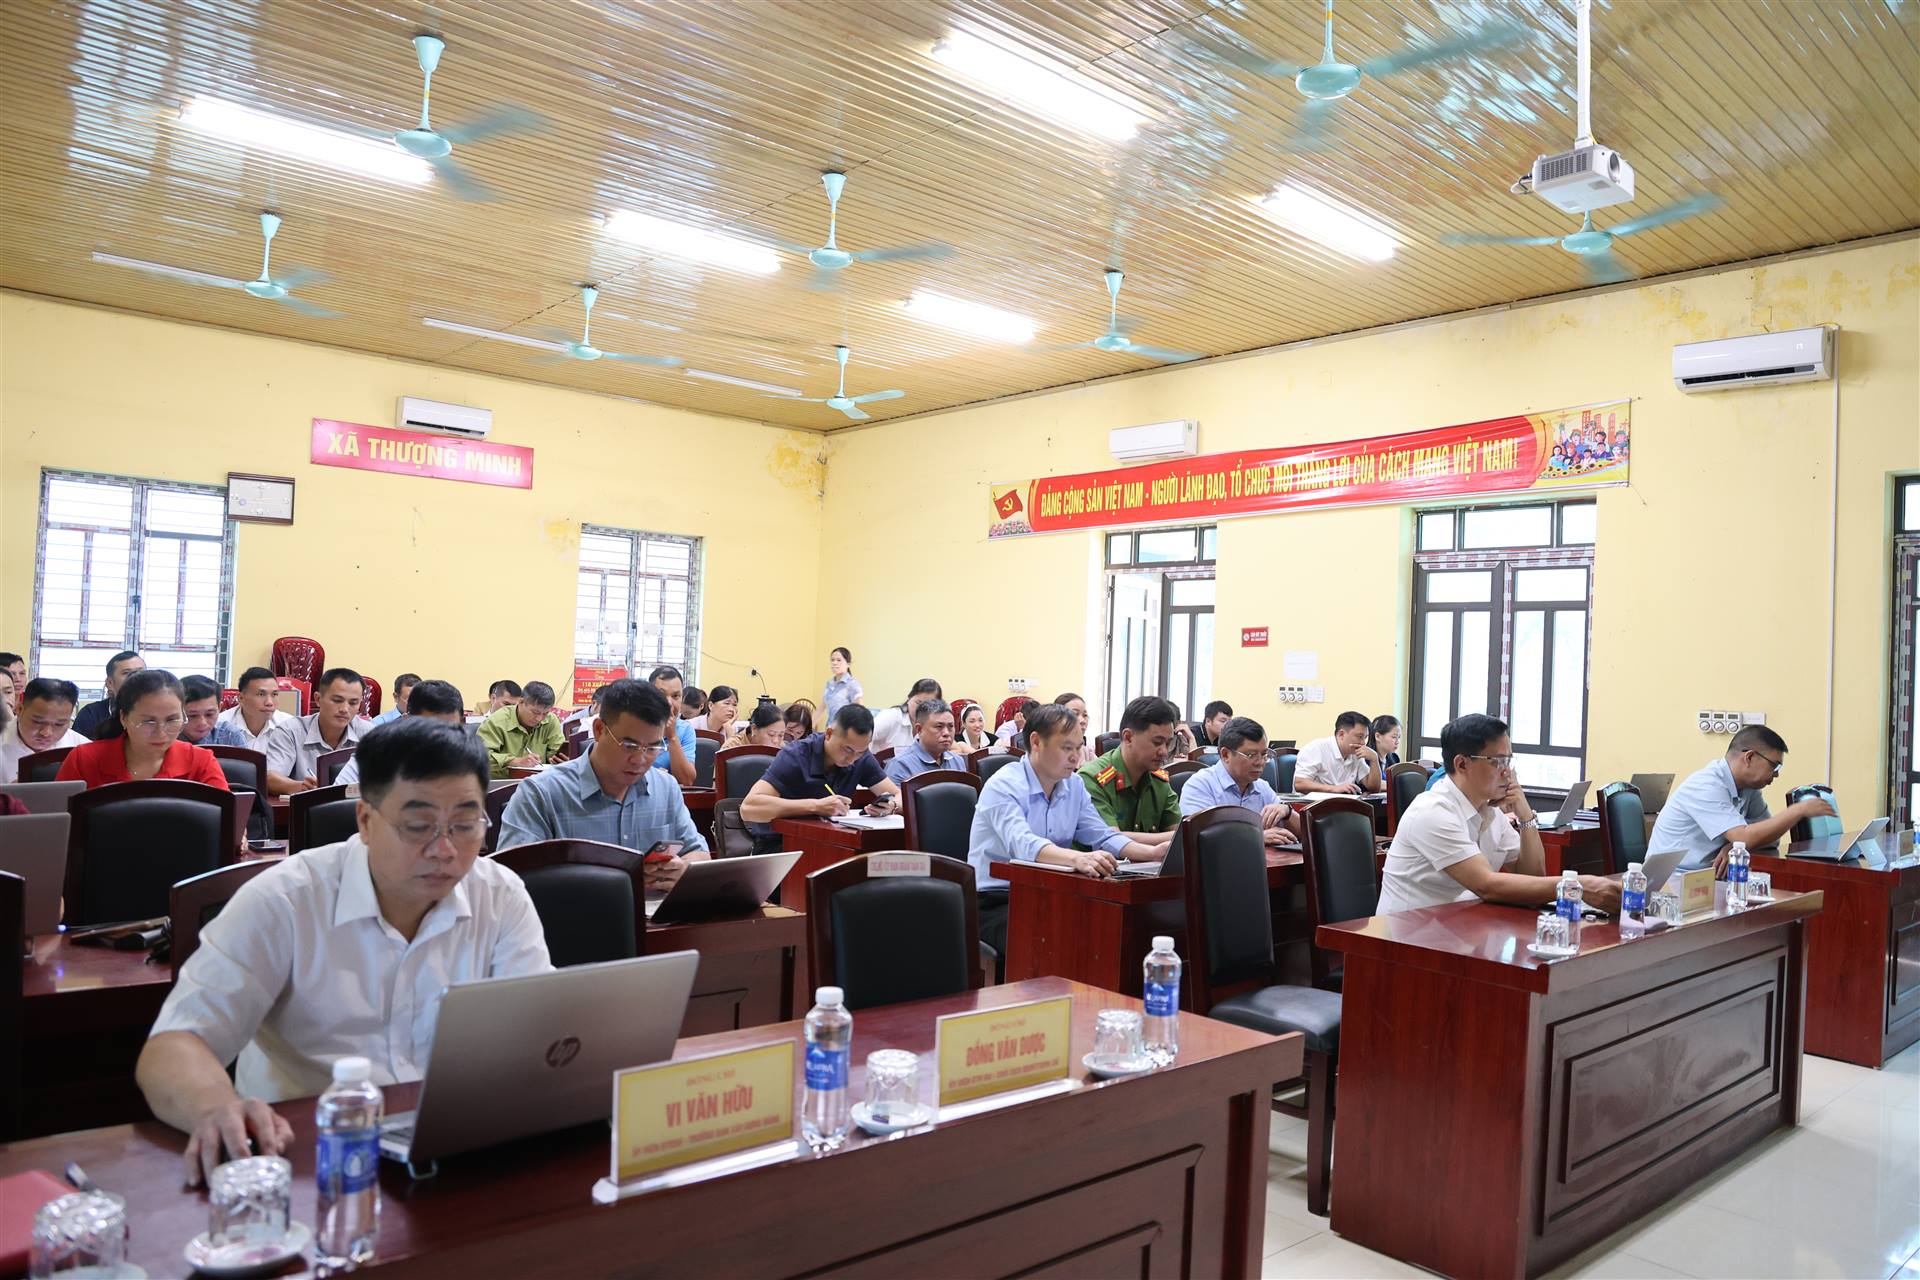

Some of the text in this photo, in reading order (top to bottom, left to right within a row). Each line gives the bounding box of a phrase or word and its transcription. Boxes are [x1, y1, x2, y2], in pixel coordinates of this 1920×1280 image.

[327, 432, 522, 476] XÃ THƯỢNG MINH
[1041, 485, 1062, 517] ĐẢNG
[1063, 485, 1085, 520] CỘNG
[1086, 479, 1104, 512] SẢN
[1105, 480, 1122, 515] VIỆT
[1123, 482, 1144, 509] NAM
[1151, 471, 1178, 506] NGƯỜI
[1180, 470, 1205, 503] LÃNH
[1206, 472, 1227, 507] ĐẠO,
[1230, 458, 1243, 498] TỔ
[1244, 461, 1271, 497] CHỨC
[1353, 445, 1376, 485] CỦA
[1379, 445, 1411, 482] CÁCH
[1413, 445, 1449, 484] MẠNG
[1453, 436, 1480, 481] VIỆT
[1482, 437, 1519, 473] NAM!
[666, 1101, 681, 1128] VI
[686, 1091, 718, 1123] VĂN
